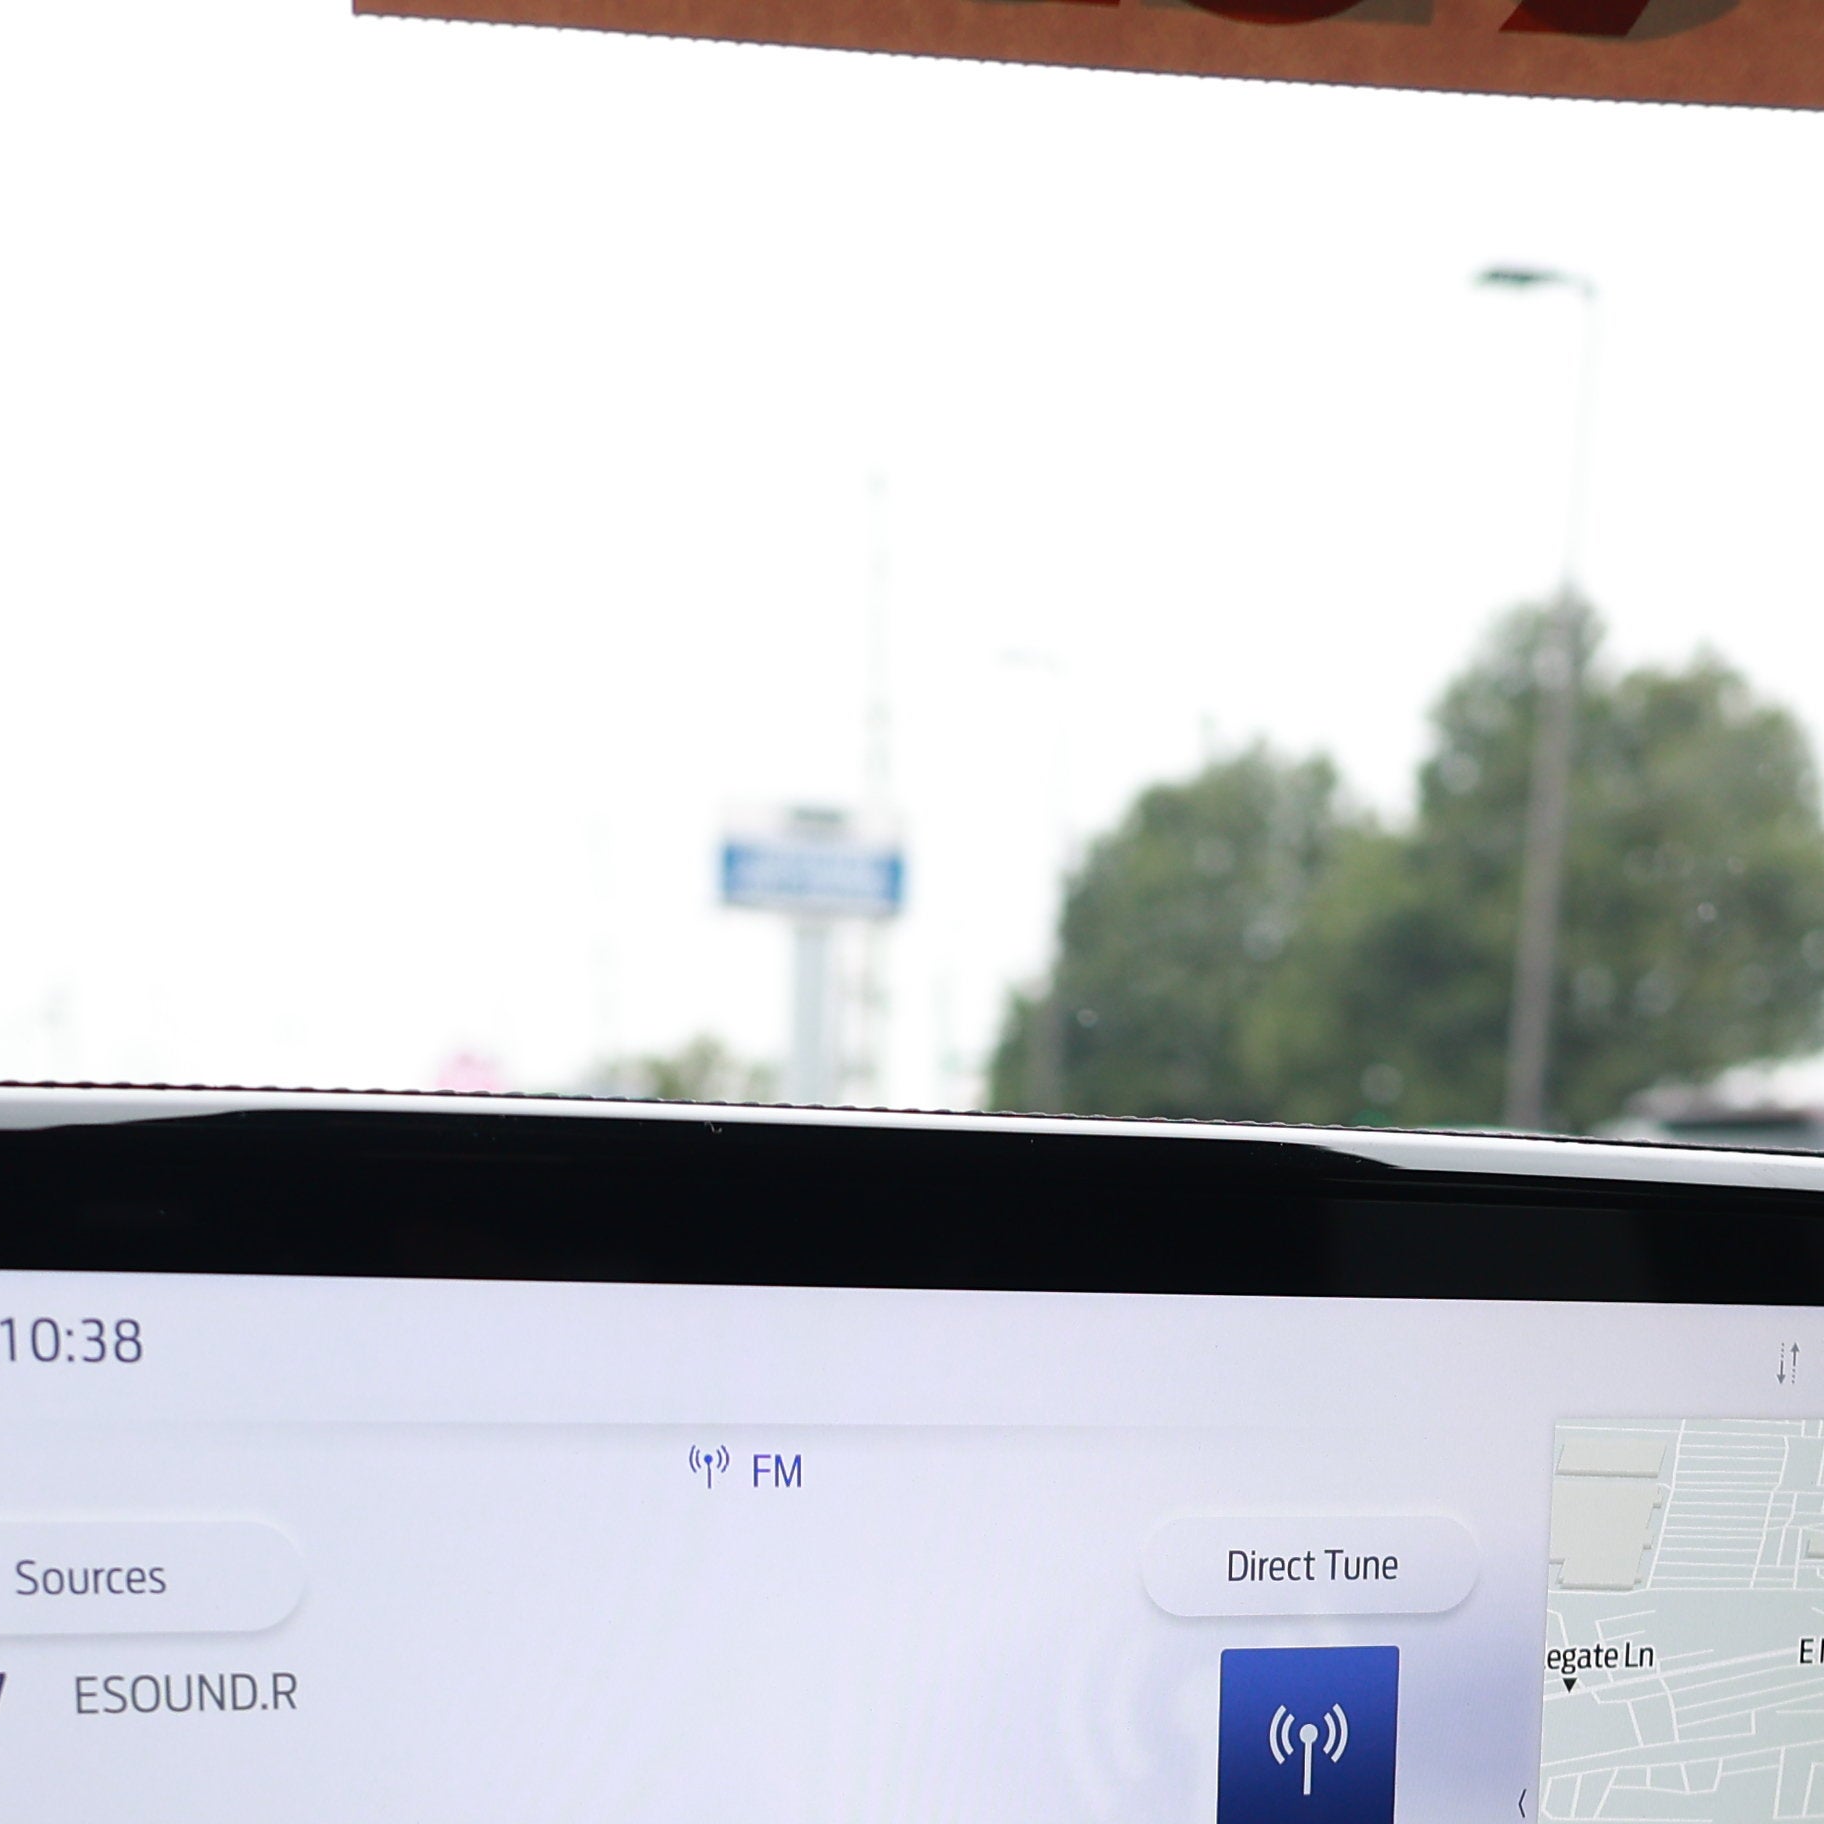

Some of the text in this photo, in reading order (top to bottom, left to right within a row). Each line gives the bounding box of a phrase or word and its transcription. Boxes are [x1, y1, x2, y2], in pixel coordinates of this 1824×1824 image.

[0, 1317, 143, 1364] 10:38
[753, 1454, 802, 1488] FM
[15, 1559, 167, 1596] Sources
[1228, 1549, 1398, 1582] Direct Tune
[1546, 1641, 1654, 1675] egate Ln
[1799, 1638, 1814, 1663] E
[75, 1672, 297, 1715] ESOUND.R
